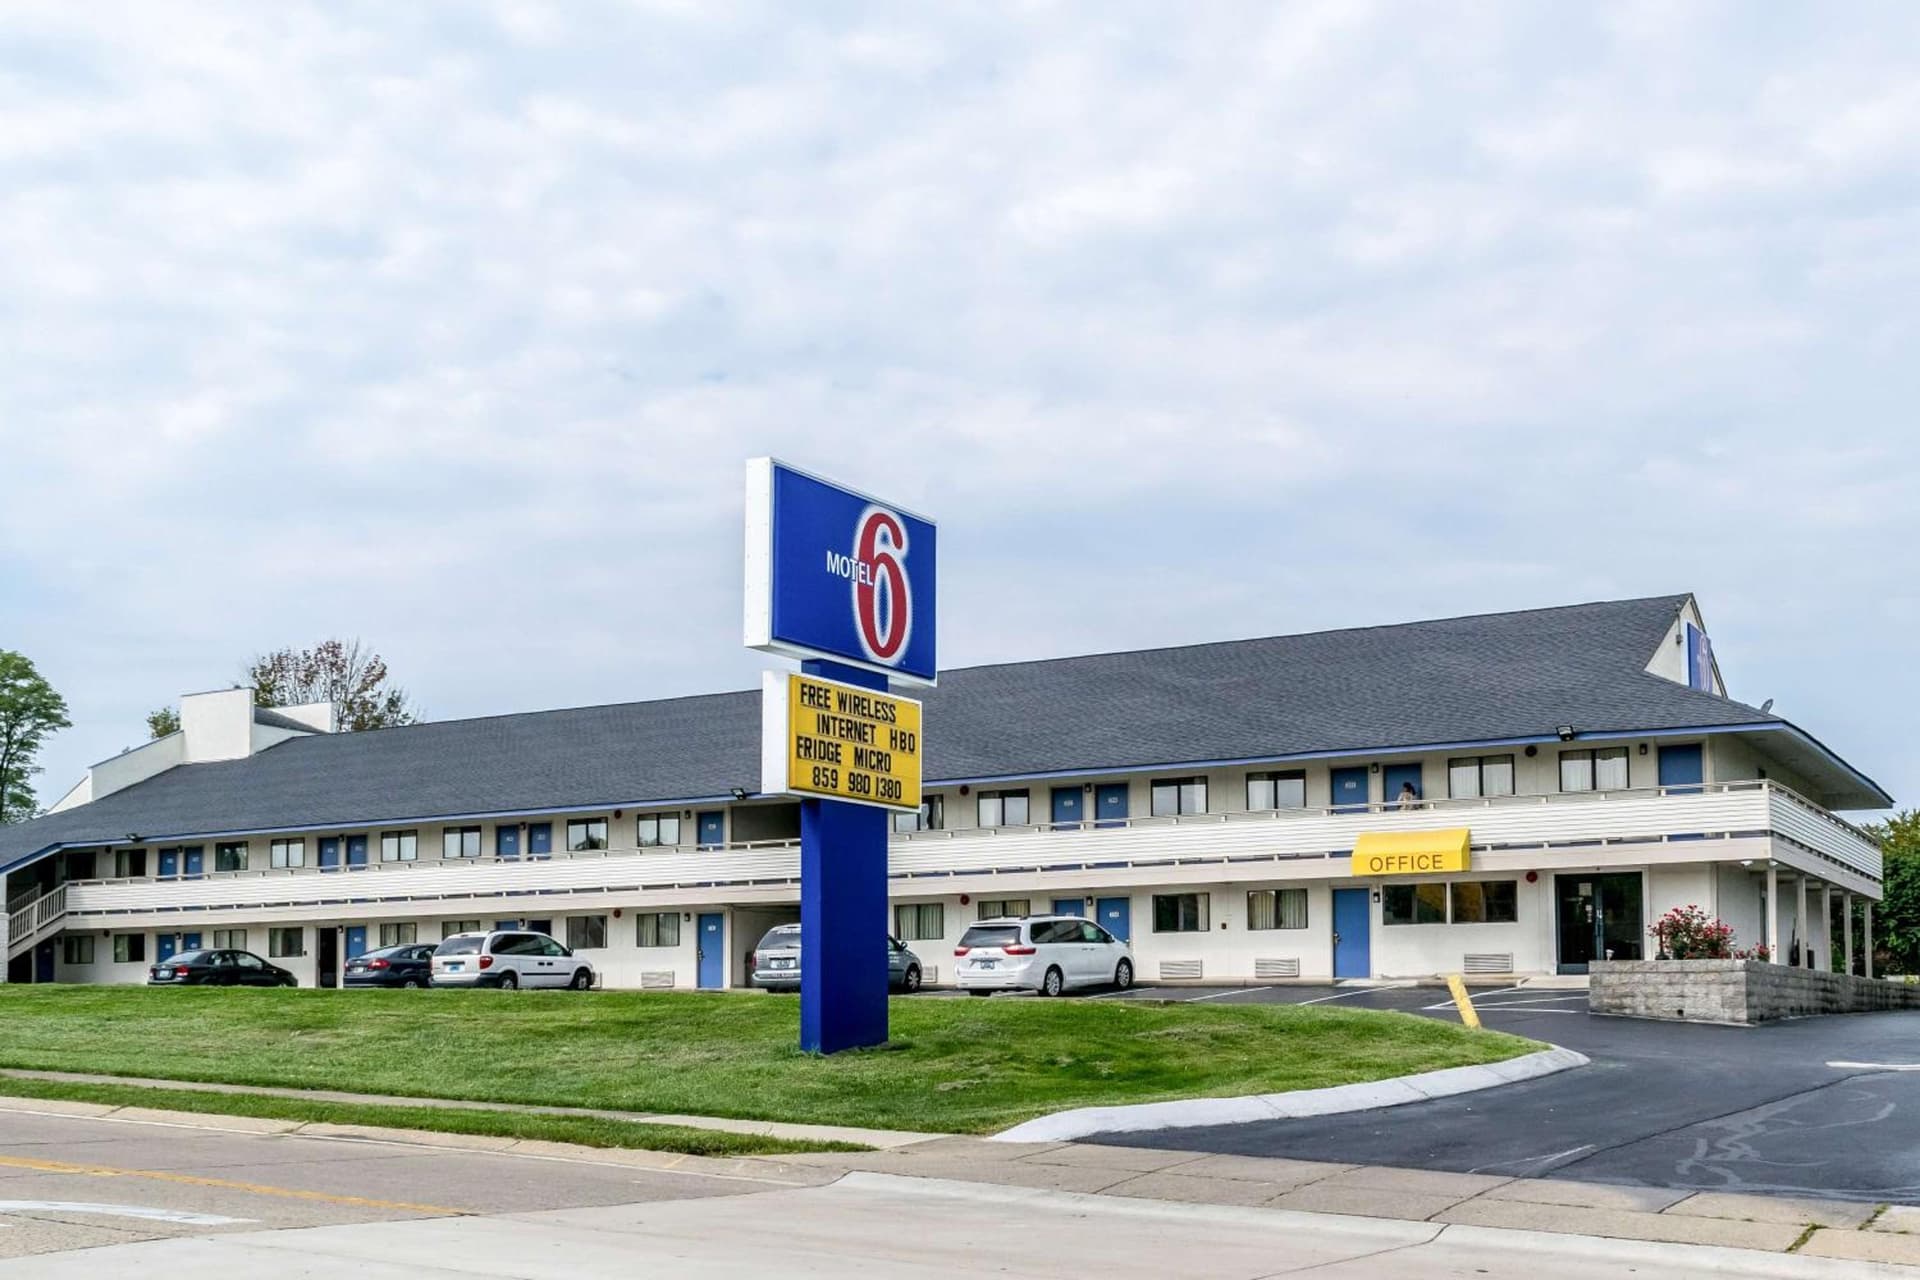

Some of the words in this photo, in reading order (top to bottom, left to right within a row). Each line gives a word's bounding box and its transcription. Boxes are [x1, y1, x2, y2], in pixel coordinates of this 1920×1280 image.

[826, 551, 873, 587] MOTEL
[855, 509, 908, 660] 6
[800, 683, 831, 709] FREE
[837, 691, 896, 723] WIRELESS
[817, 713, 876, 744] INTERNET
[889, 729, 915, 753] HBO
[796, 735, 842, 764] FRIDGE
[854, 746, 891, 772] MICRO
[812, 766, 838, 789] 859
[848, 772, 871, 794] 980
[875, 776, 902, 800] 1380
[1370, 854, 1443, 872] OFFICE
